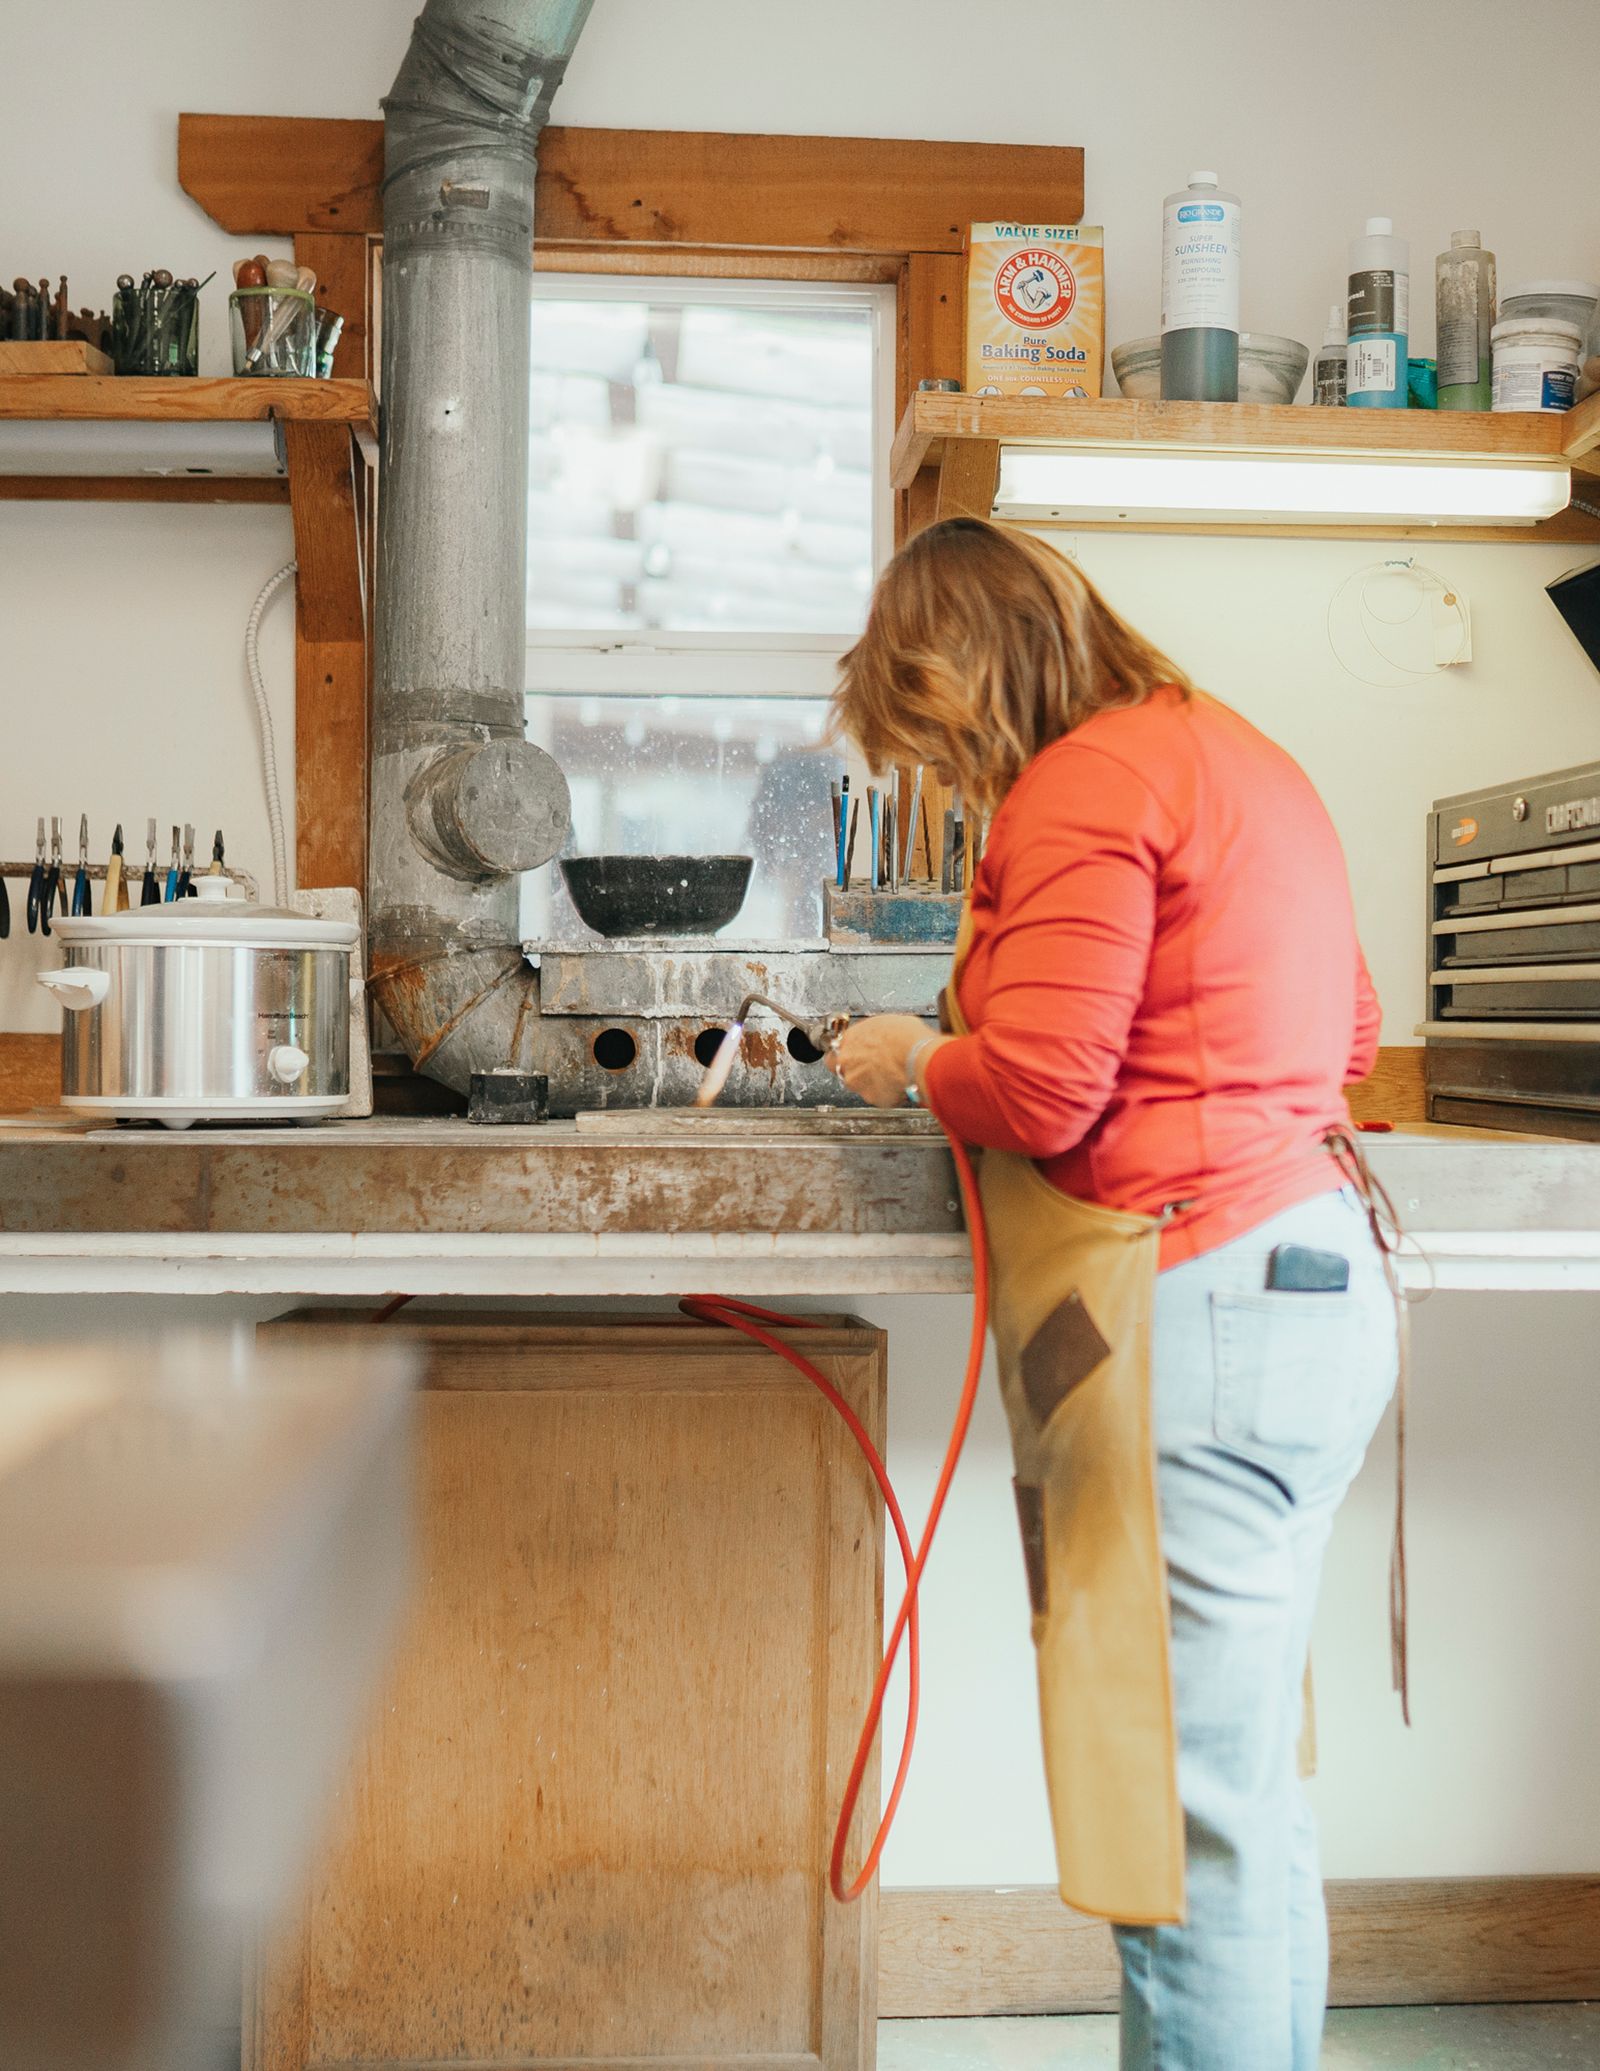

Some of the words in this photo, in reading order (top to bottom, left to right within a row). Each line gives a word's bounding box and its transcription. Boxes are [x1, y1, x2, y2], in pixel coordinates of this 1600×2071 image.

[995, 226, 1040, 238] VALUE
[1044, 228, 1079, 241] SIZE!
[1189, 234, 1214, 242] SUPER
[1174, 243, 1228, 257] SUNSHEEN
[1180, 257, 1222, 266] BURNISHING
[999, 264, 1018, 297] ARM
[1014, 257, 1027, 269] &
[1027, 253, 1072, 298] HAMMER
[1181, 267, 1222, 275] COMPOUND
[1023, 336, 1047, 345] Pure
[982, 344, 1040, 362] Baking
[1046, 346, 1086, 361] Soda
[1019, 375, 1063, 384] COUNTLESS
